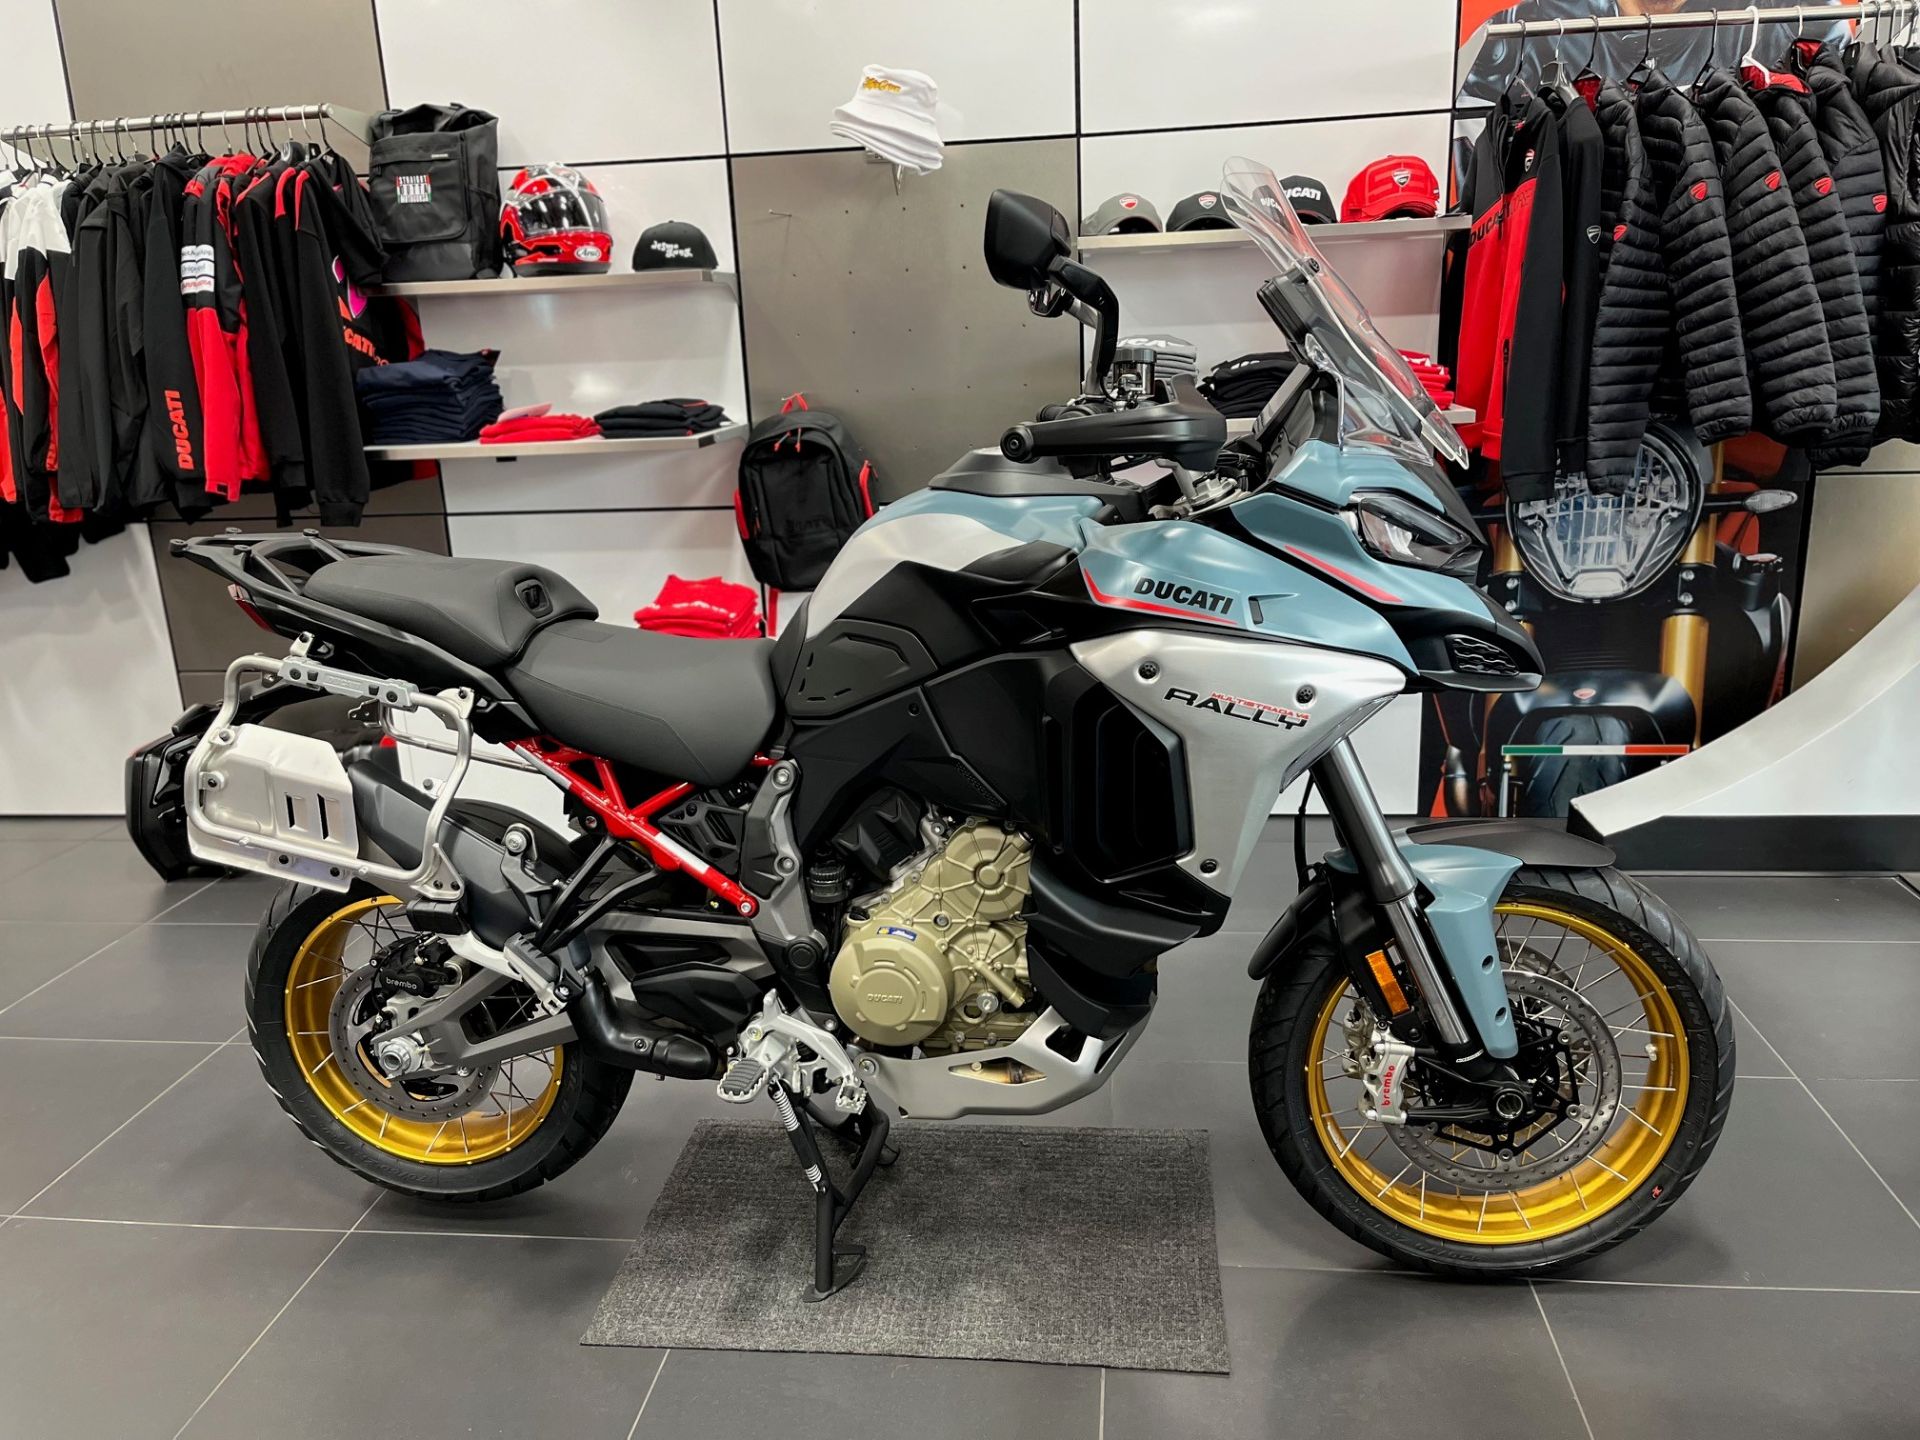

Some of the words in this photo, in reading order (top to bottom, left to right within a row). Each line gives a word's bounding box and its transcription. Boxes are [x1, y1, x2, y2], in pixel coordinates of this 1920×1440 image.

[1284, 187, 1321, 201] UCATI
[164, 390, 194, 469] DUCATI
[1134, 577, 1234, 615] DUCATI
[1164, 687, 1308, 730] RALLY
[1211, 692, 1293, 717] MULTISTRADA
[386, 976, 417, 990] brembo
[867, 993, 903, 1004] DUCATI
[1381, 1065, 1395, 1106] brembo
